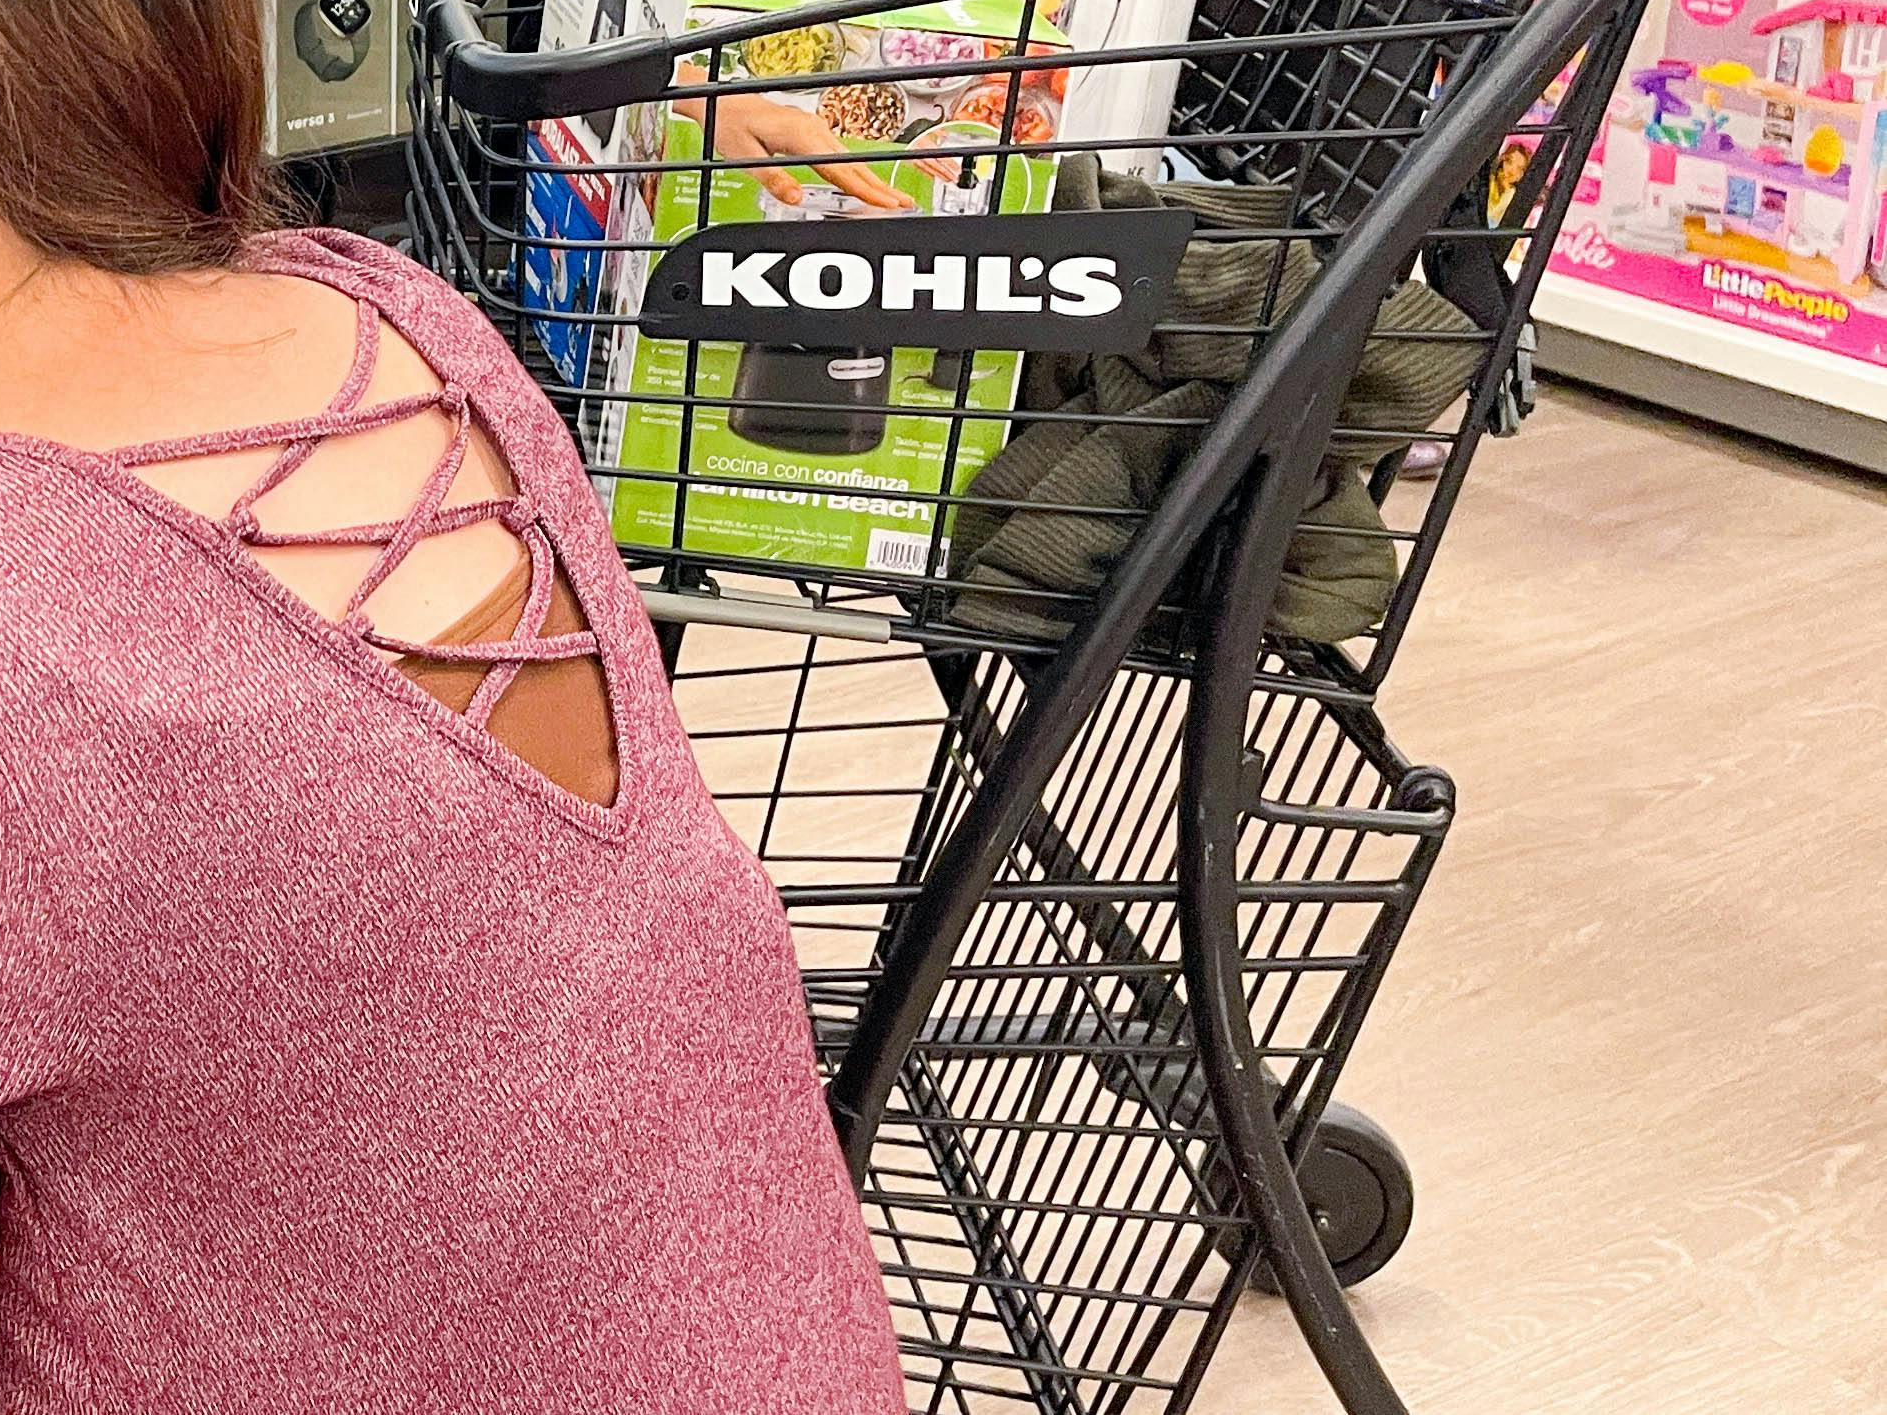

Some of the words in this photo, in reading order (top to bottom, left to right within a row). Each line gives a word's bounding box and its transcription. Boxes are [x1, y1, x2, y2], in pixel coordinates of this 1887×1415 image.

[286, 114, 324, 131] versa
[700, 251, 1123, 318] KOHL'S
[705, 454, 769, 476] cocina
[773, 462, 810, 481] con
[812, 467, 910, 492] confianza
